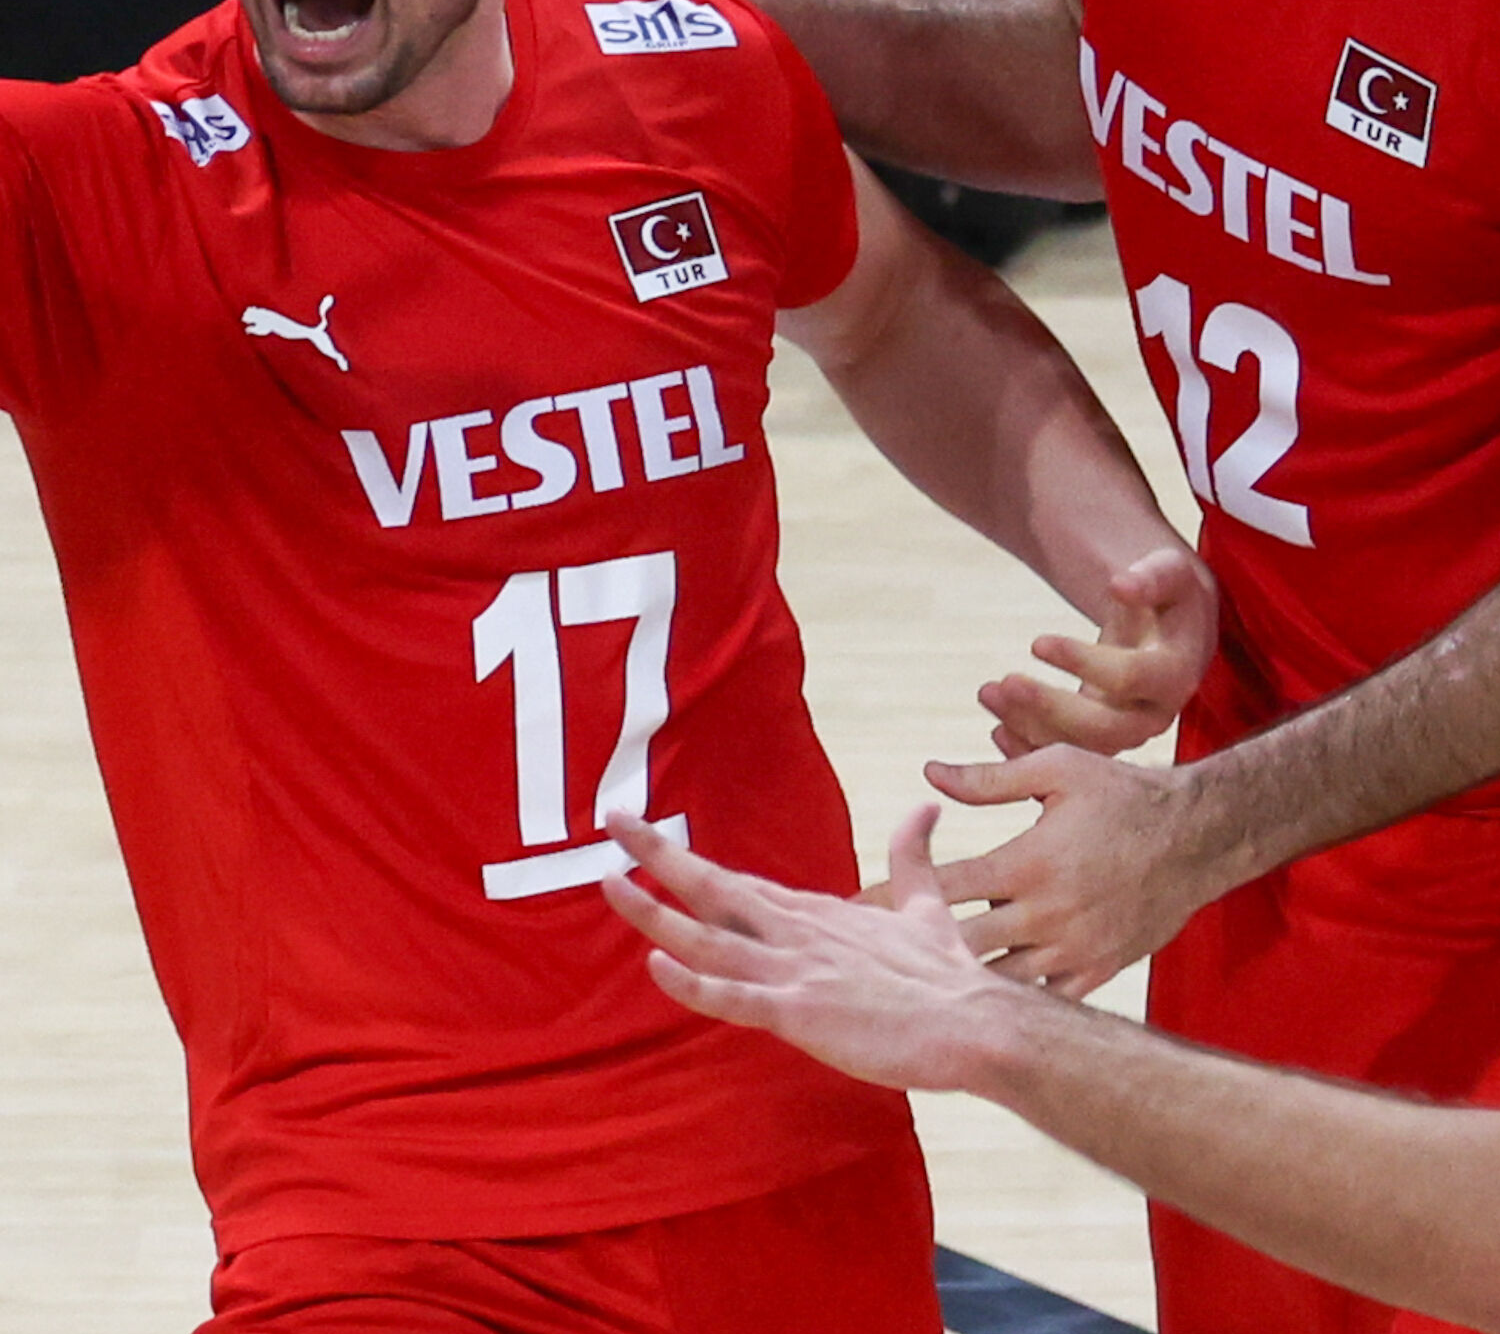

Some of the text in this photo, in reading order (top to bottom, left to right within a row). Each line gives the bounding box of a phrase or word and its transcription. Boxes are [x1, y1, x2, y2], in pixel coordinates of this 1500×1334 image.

[1080, 36, 1390, 286] VESTEL
[1351, 113, 1402, 153] TUR
[656, 263, 706, 289] TUR
[340, 365, 745, 527] VESTEL
[1136, 273, 1315, 548] 12
[472, 551, 676, 846] 17
